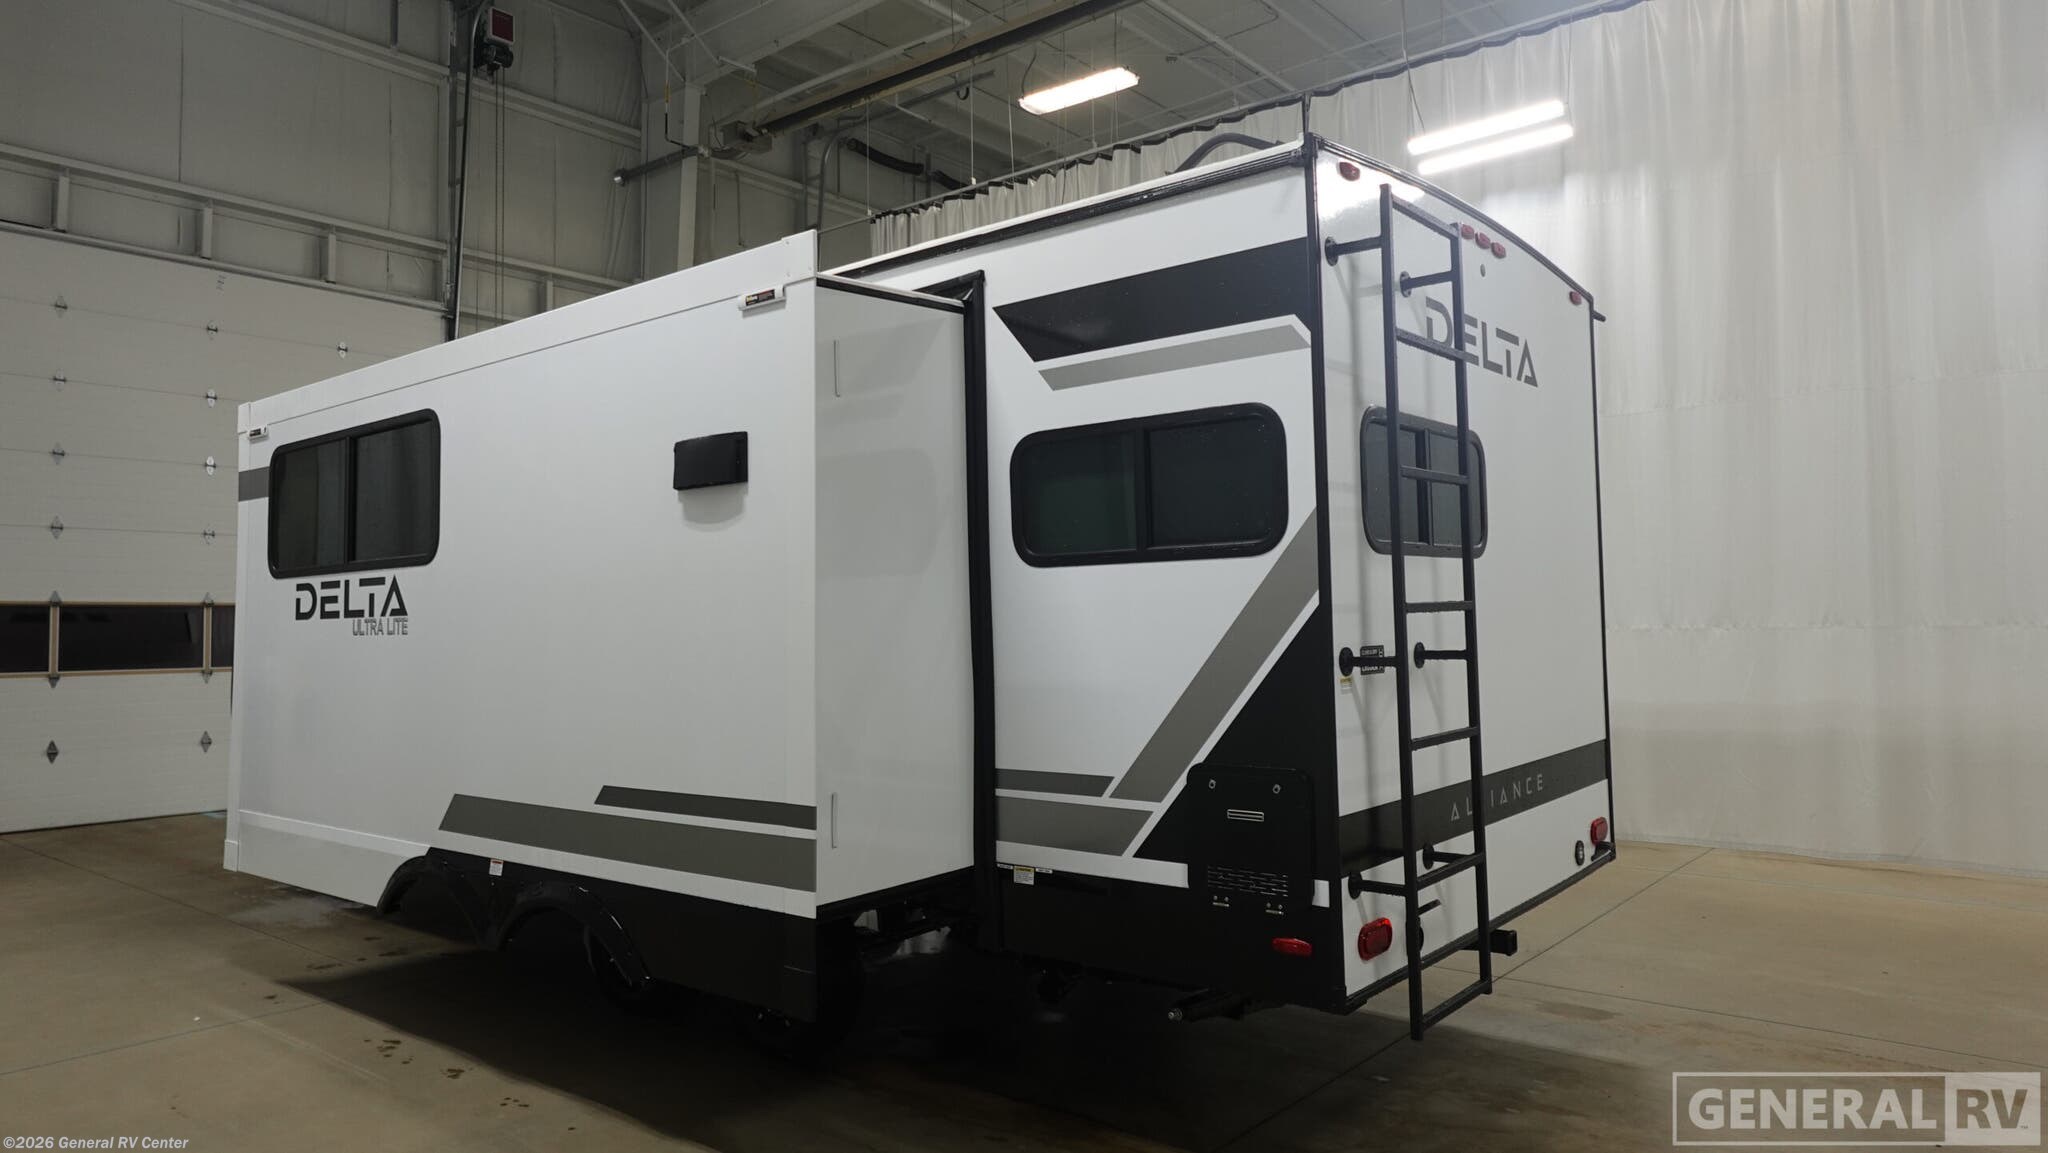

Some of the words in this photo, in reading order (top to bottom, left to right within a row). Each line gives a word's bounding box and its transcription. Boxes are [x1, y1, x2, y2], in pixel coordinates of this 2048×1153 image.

[1425, 296, 1538, 388] DELTA
[295, 574, 408, 621] DELTA
[352, 618, 385, 636] ULTRA
[387, 617, 408, 636] LITE
[1450, 773, 1544, 821] ALIANCE
